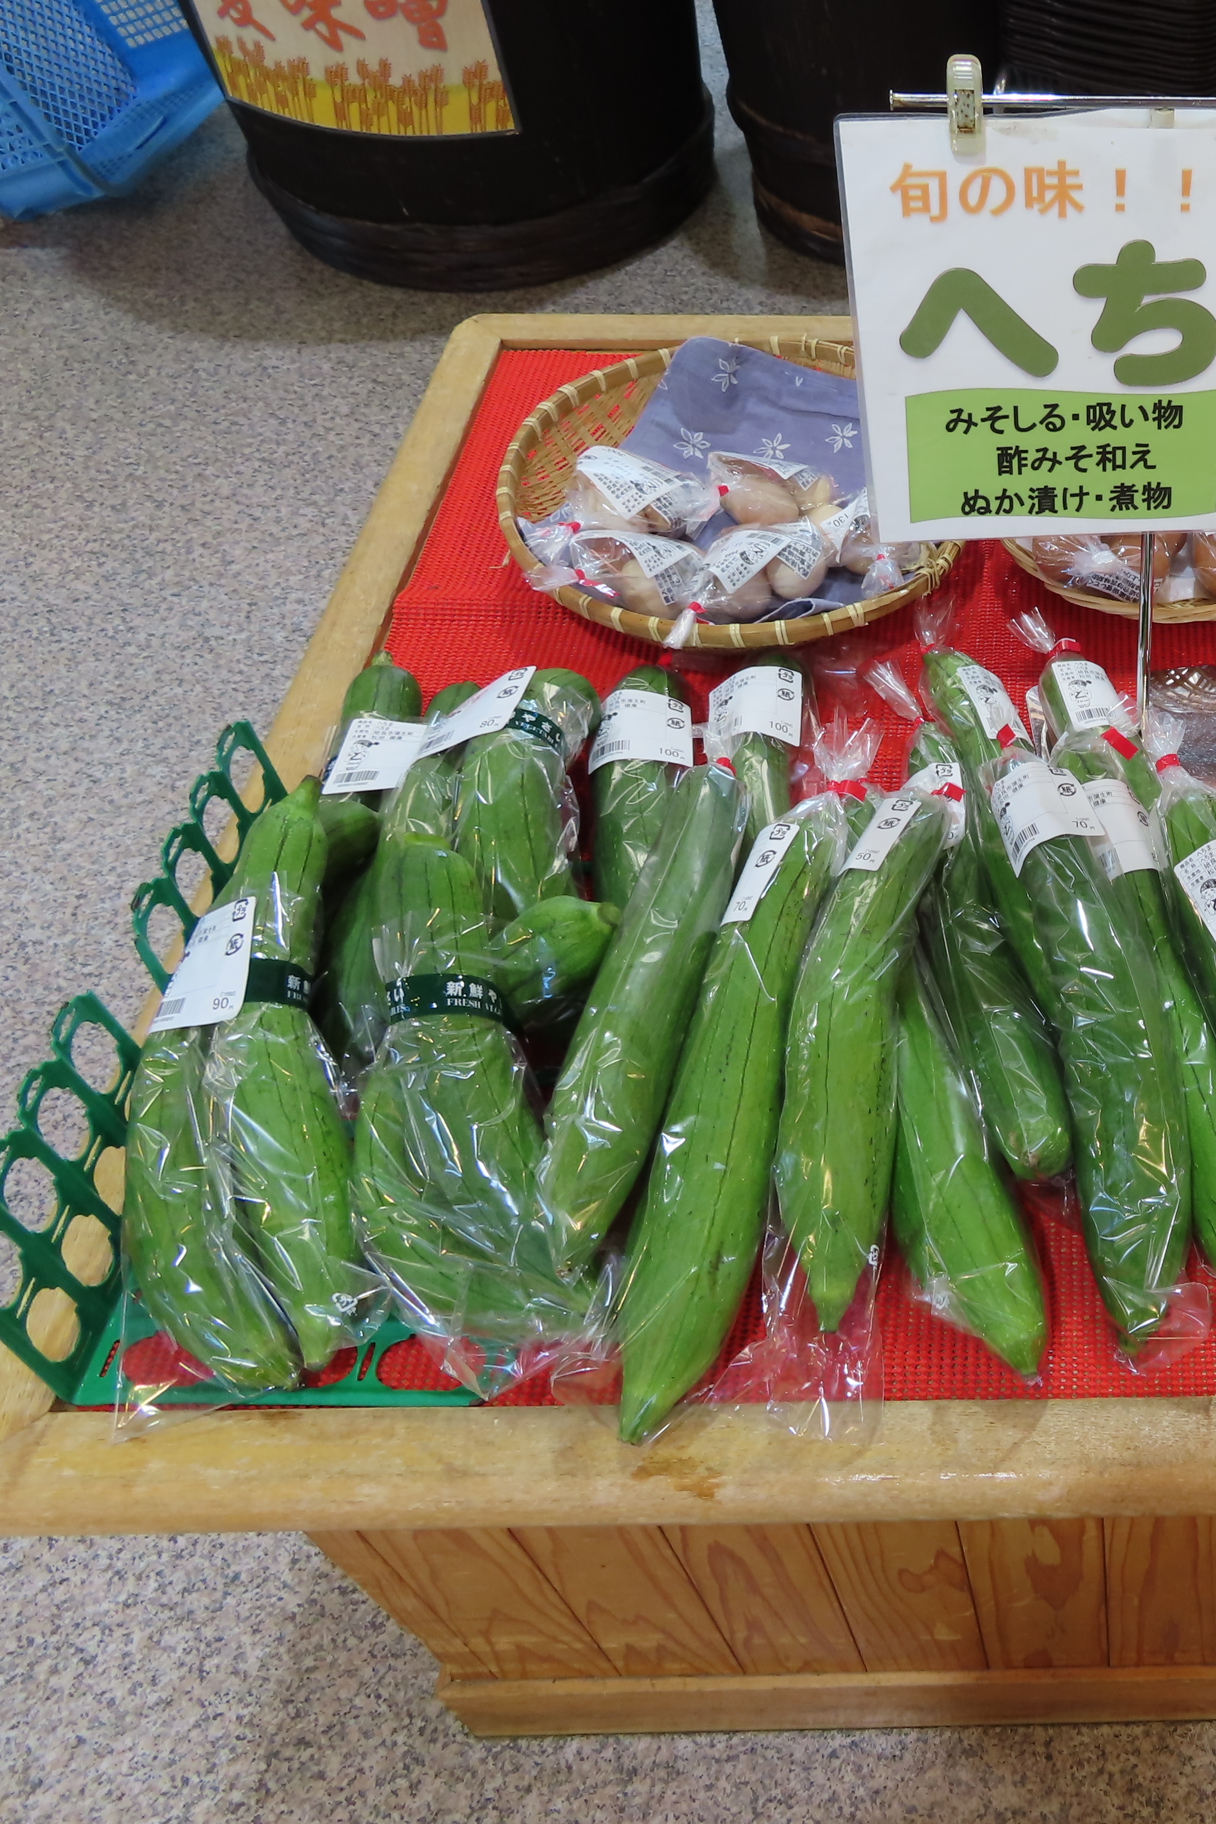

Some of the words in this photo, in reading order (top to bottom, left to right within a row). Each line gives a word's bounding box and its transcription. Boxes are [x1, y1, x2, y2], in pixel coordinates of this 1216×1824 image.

[890, 160, 1194, 222] 旬の味！！
[944, 400, 1184, 434] みそしる・吸い物
[996, 442, 1157, 476] 酢みそ和え
[960, 484, 1173, 517] ぬか漬け・煮物
